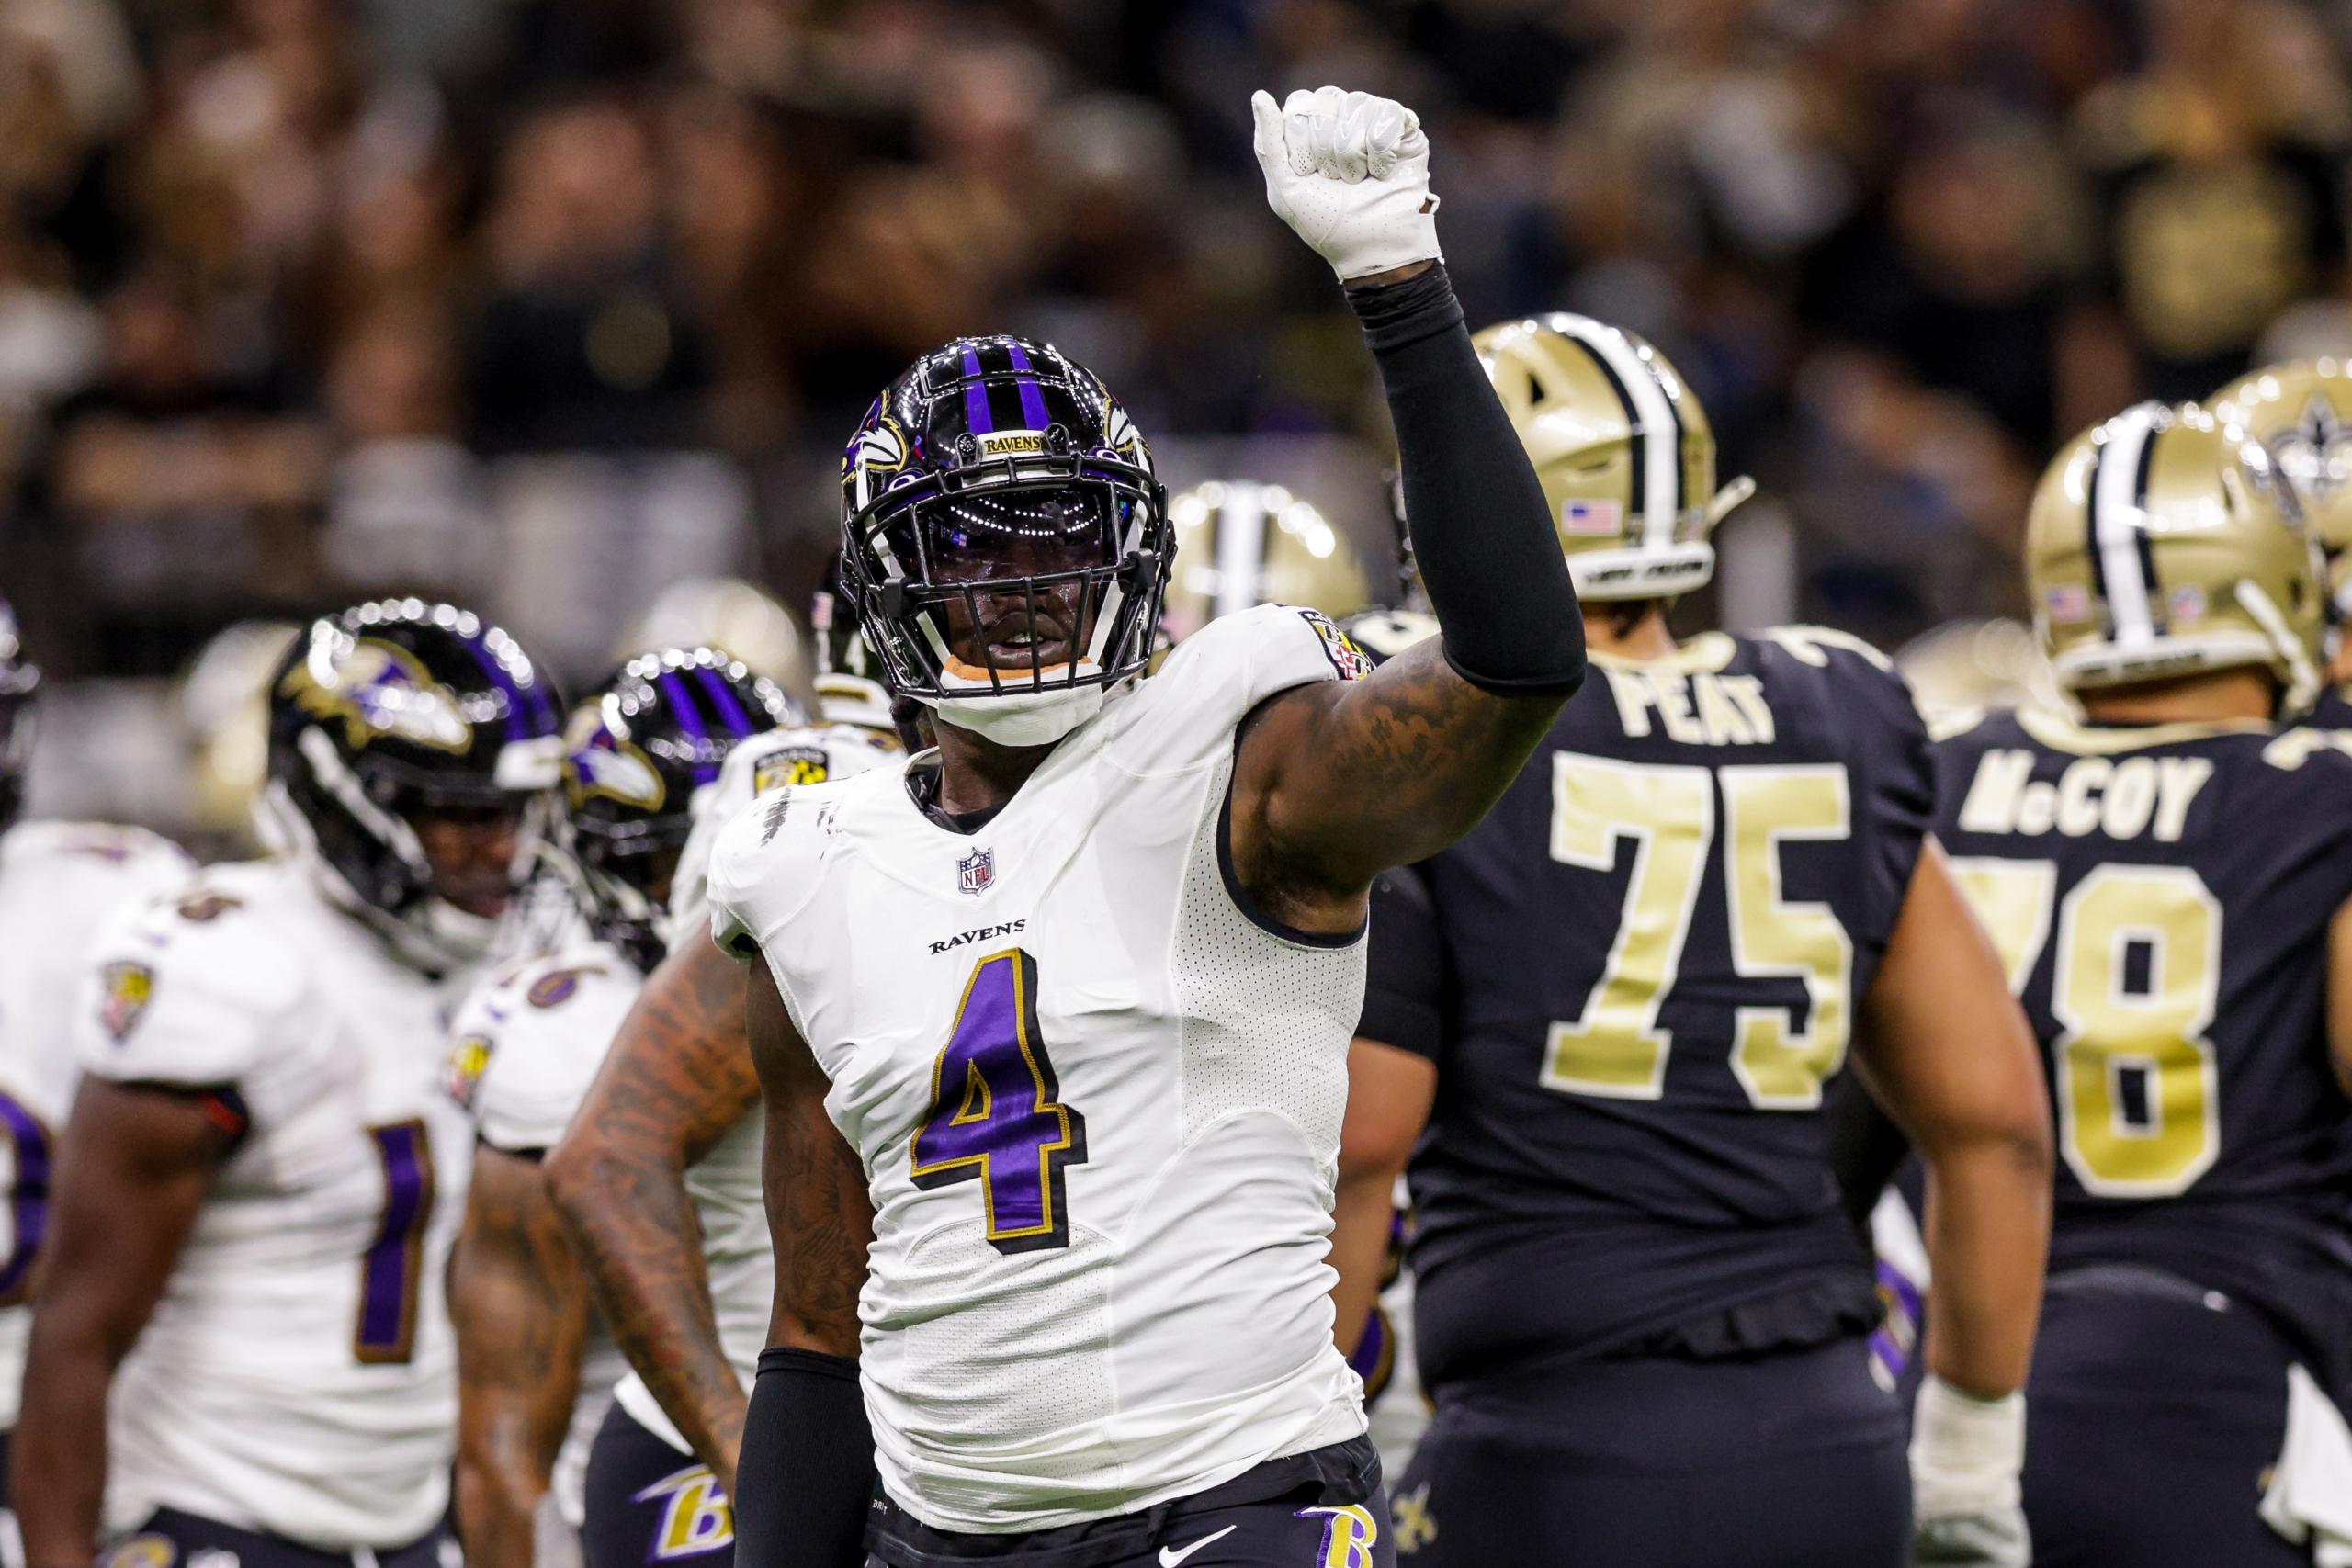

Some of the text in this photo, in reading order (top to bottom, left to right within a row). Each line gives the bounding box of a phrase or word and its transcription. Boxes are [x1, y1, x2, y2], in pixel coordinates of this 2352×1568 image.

[984, 435, 1040, 455] RAVENS
[1605, 671, 1775, 745] PEAT
[1958, 748, 2215, 843] McCOY
[963, 866, 989, 887] NFL
[928, 919, 1027, 955] RAVENS
[1540, 750, 1854, 1111] 75
[910, 946, 1089, 1256] 4
